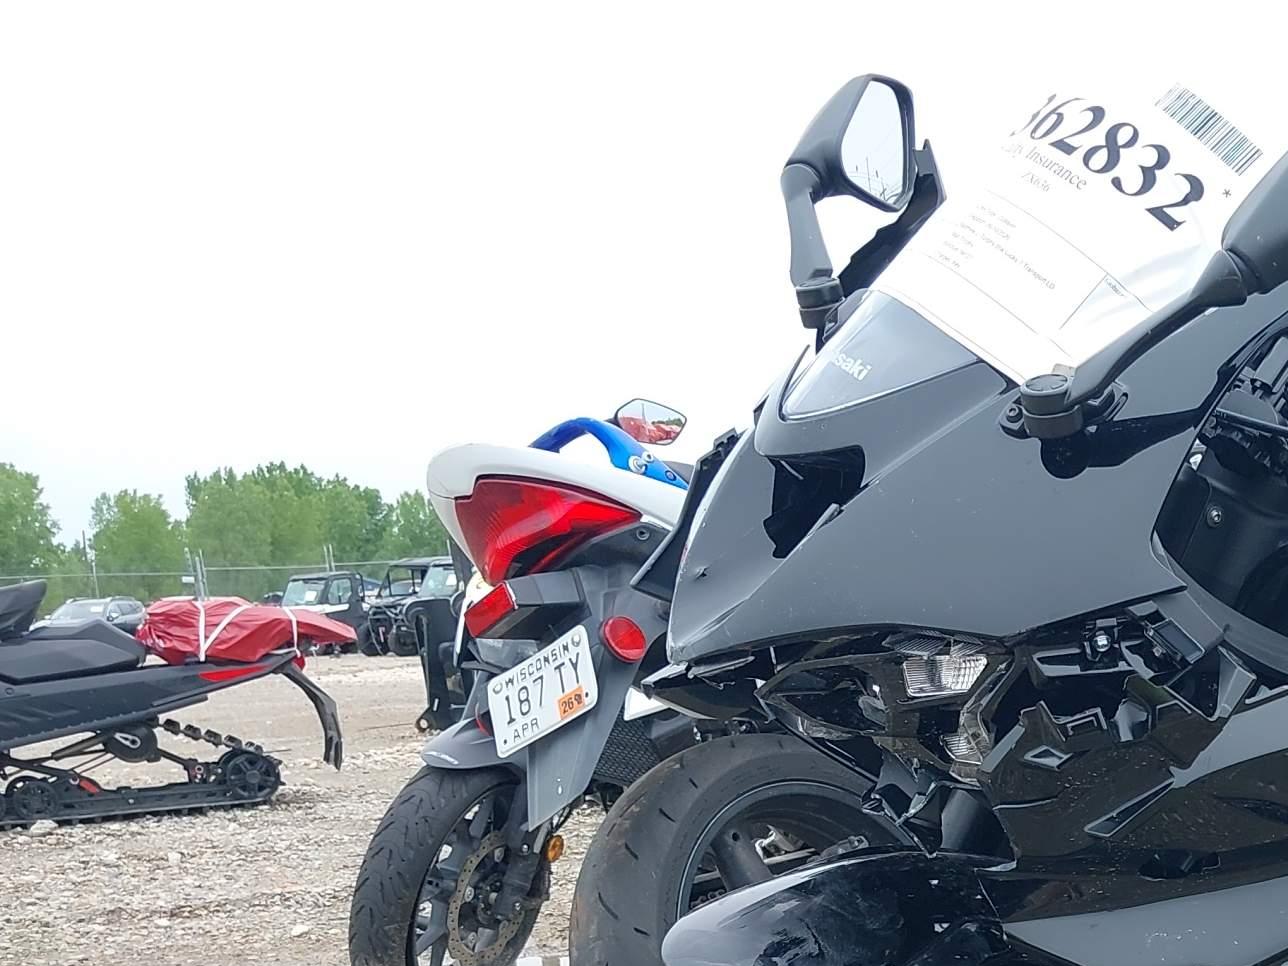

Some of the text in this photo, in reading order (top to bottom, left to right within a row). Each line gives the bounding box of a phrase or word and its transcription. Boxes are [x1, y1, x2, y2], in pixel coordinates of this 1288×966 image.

[1025, 146, 1087, 190] Insurance
[505, 642, 570, 688] WISCONSIN
[505, 652, 580, 725] 187 TY
[561, 697, 574, 714] 26
[513, 717, 540, 743] APR
